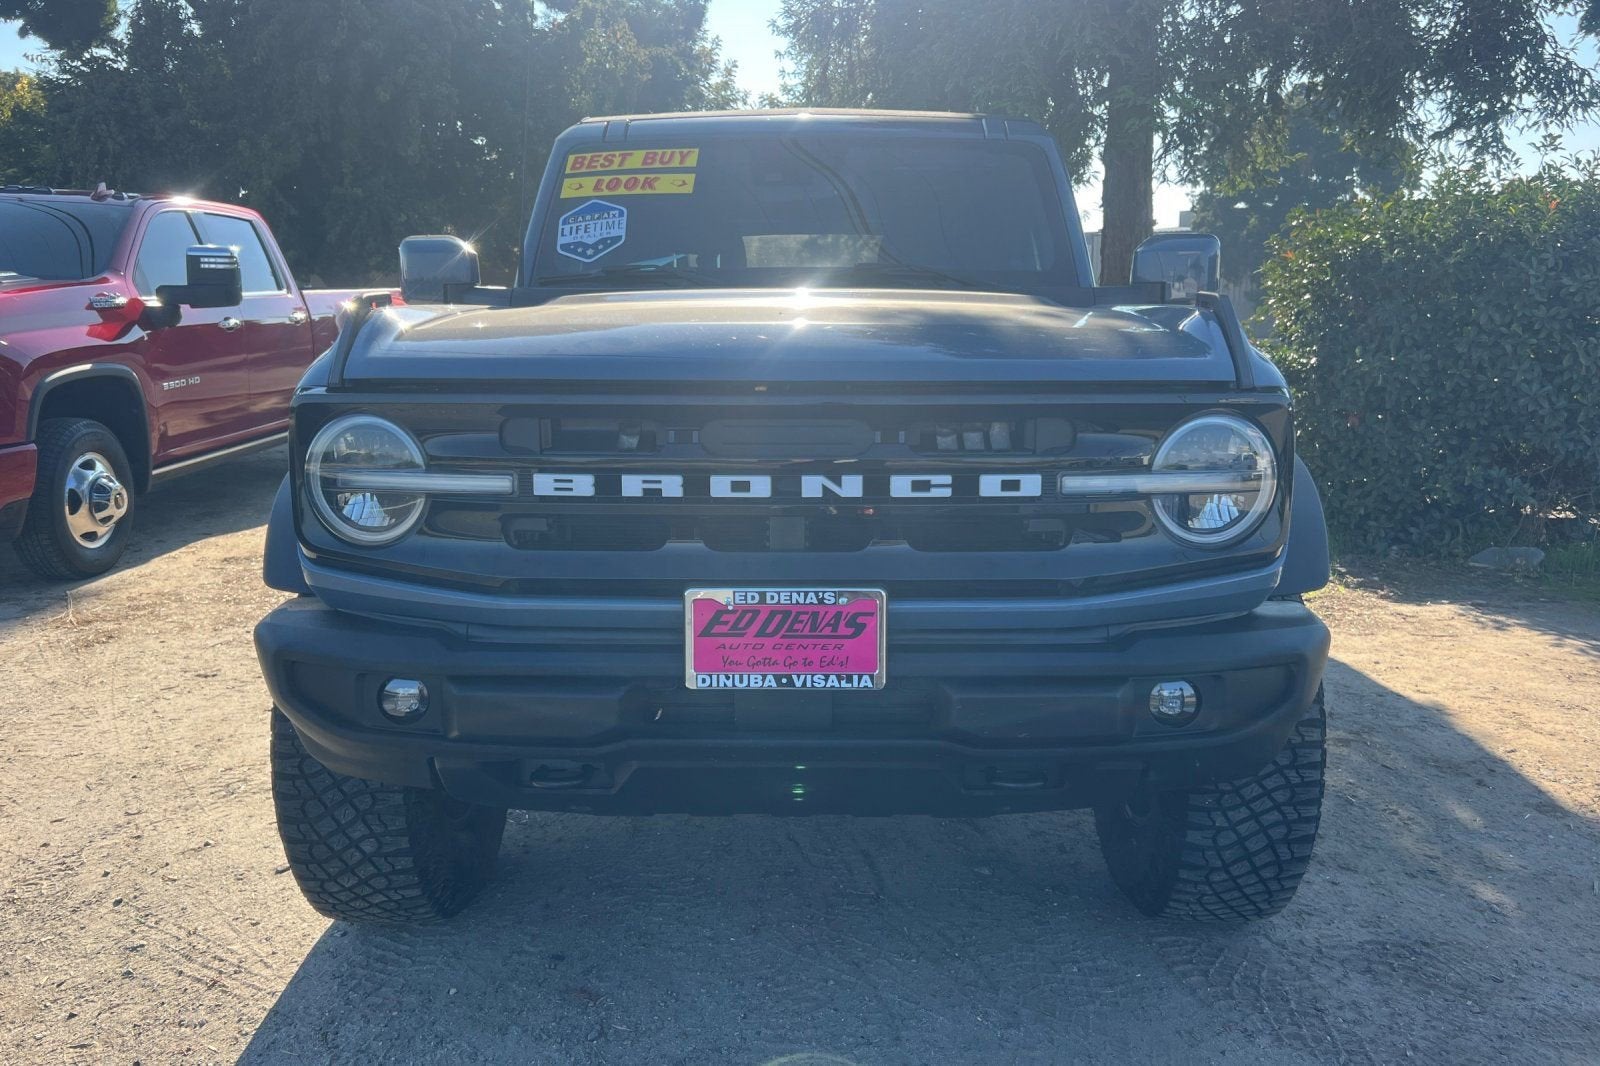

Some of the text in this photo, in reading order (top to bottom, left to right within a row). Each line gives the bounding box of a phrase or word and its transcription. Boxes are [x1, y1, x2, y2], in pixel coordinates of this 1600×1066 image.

[569, 150, 693, 172] BEST BUY
[592, 176, 660, 193] LOOK
[568, 211, 619, 224] CARFAX
[560, 219, 624, 237] LIFETIME
[162, 376, 201, 391] 3500 HD
[532, 473, 1043, 498] BRONCO
[734, 592, 836, 604] ED DENA'S
[697, 609, 875, 639] ED DENA'S
[722, 655, 849, 669] You Gotta Go to Ed's!
[697, 674, 873, 687] DINUBA VISALIA
